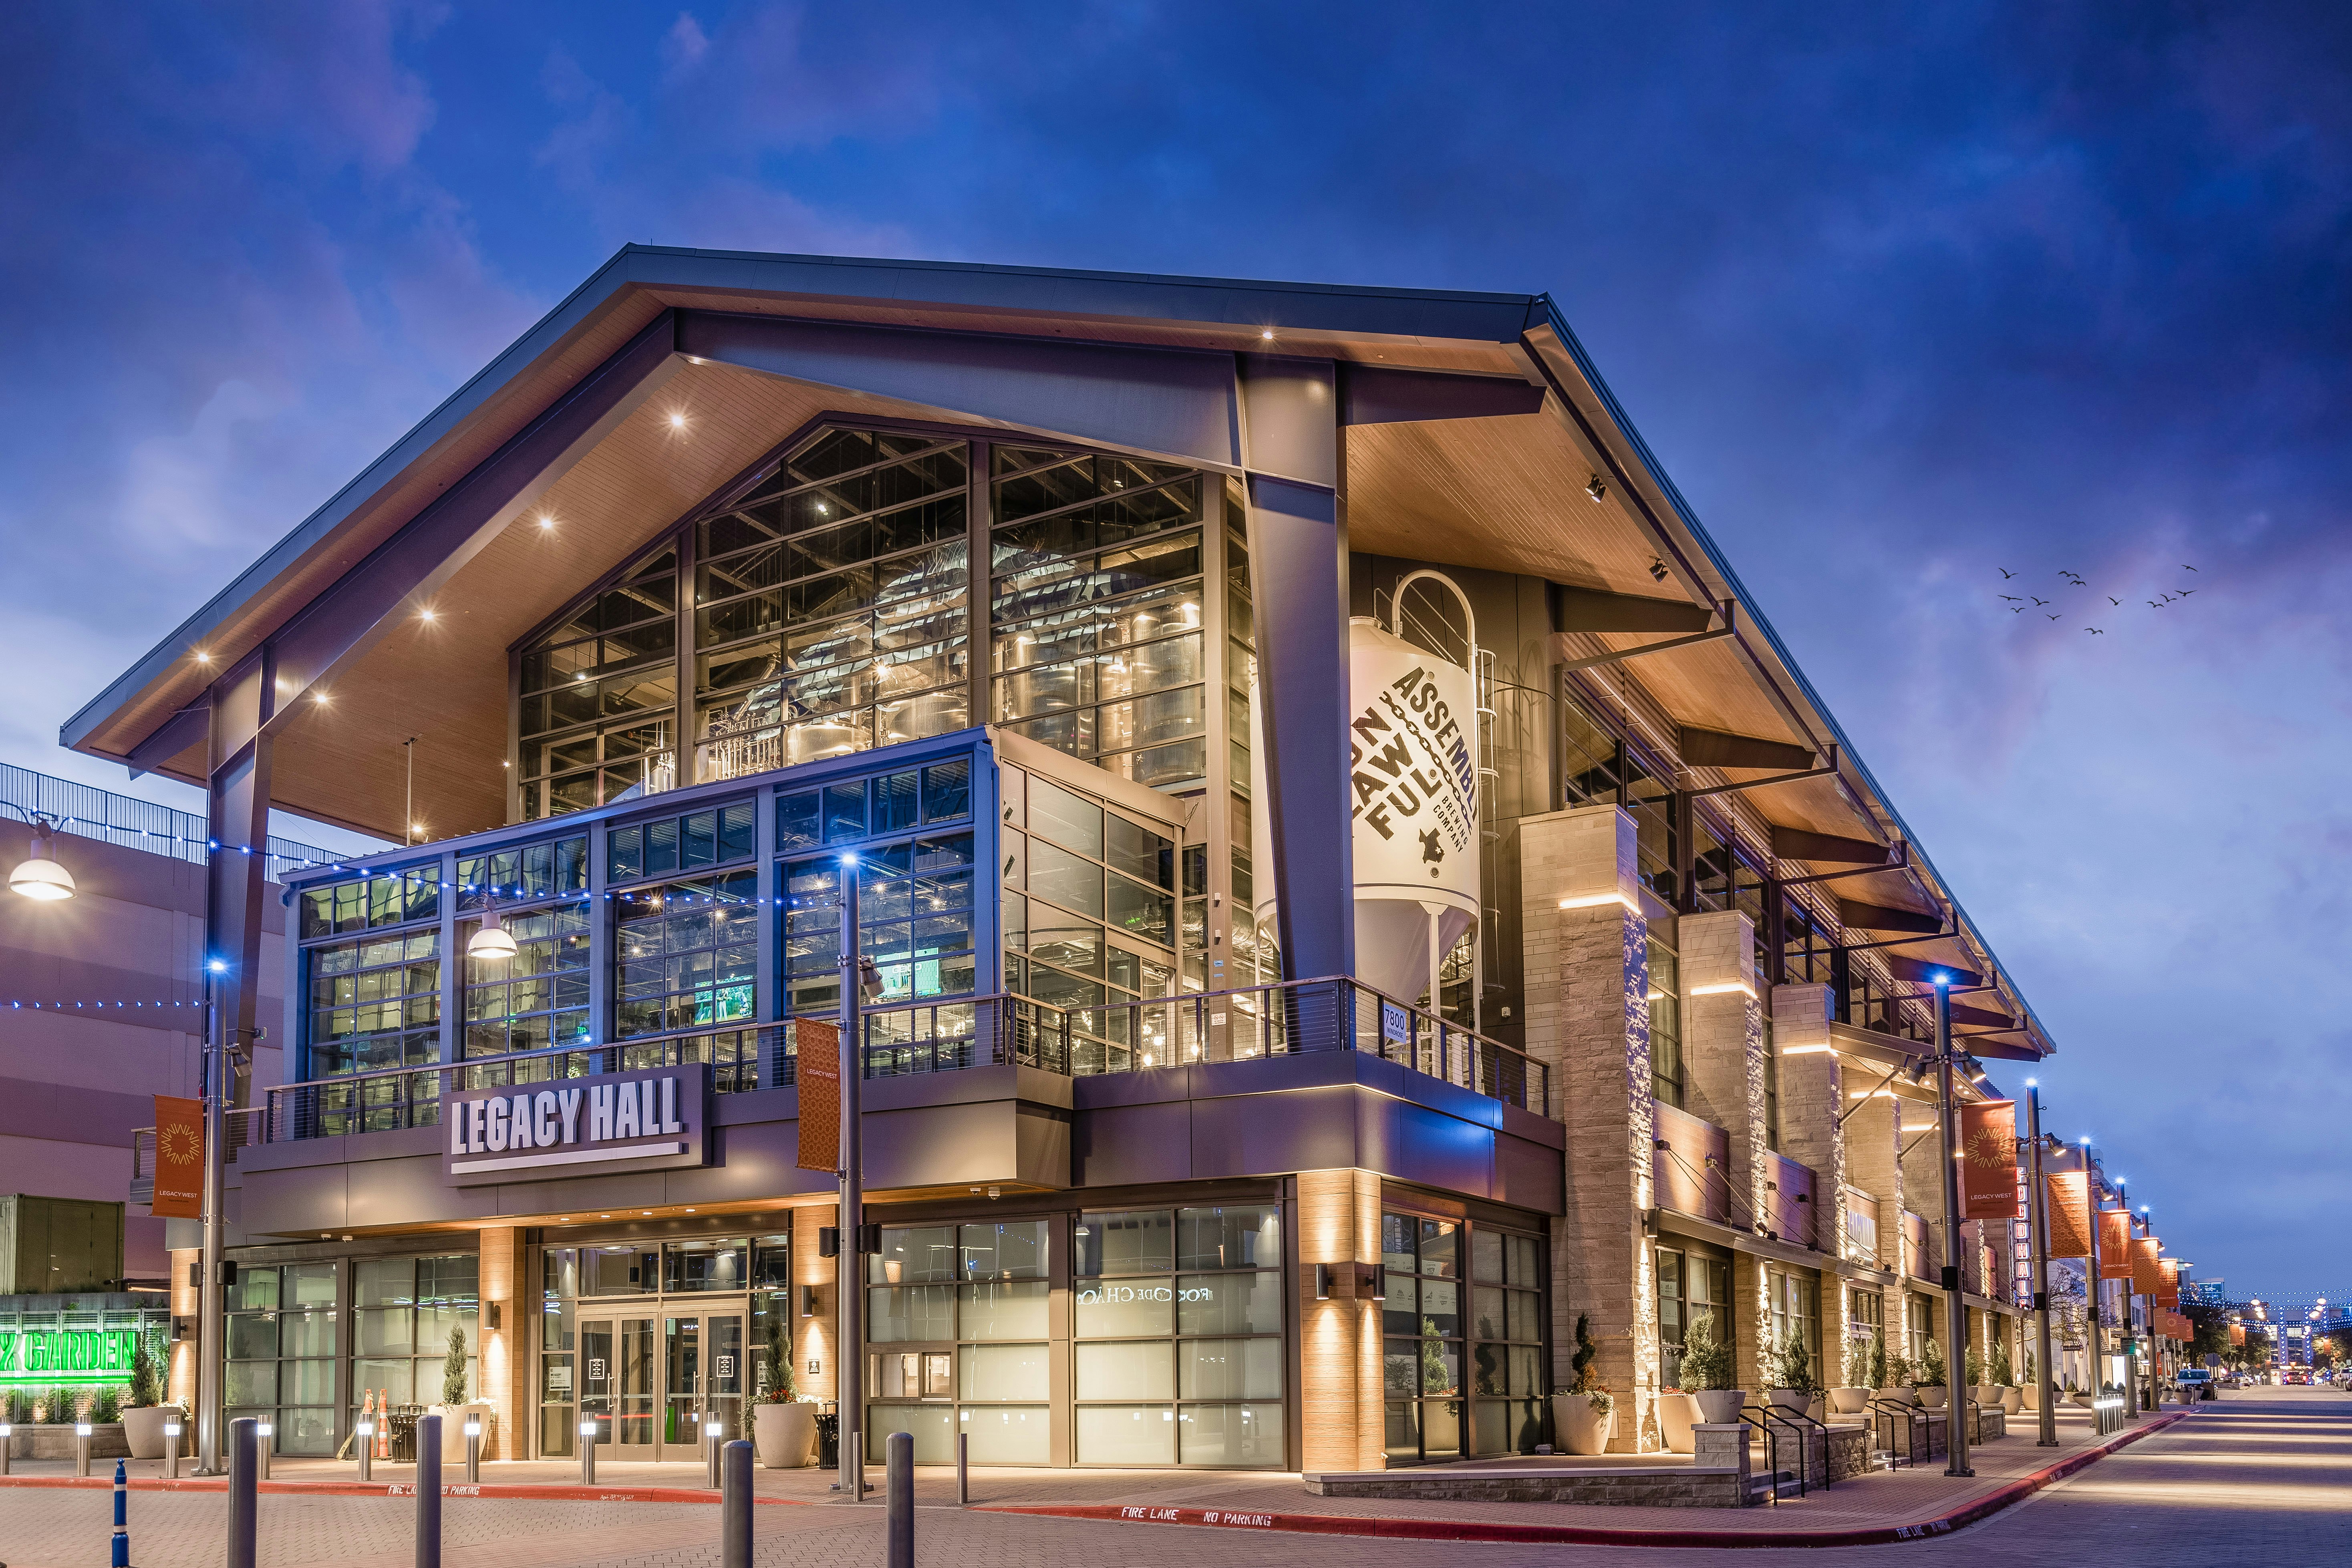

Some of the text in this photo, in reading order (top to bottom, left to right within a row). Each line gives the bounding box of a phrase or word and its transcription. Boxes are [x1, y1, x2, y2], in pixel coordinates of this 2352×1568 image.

[1392, 666, 1477, 822] ASSEMBL
[1352, 733, 1413, 819] AW
[1365, 768, 1443, 840] FUL
[1442, 795, 1468, 845] BREWING
[1433, 805, 1463, 853] COMPANY
[1385, 1008, 1404, 1030] 7800
[1387, 1027, 1404, 1039] WINDROSE
[807, 1068, 825, 1077] LEGACY
[451, 1077, 682, 1154] LEGACY HALL
[25, 1332, 136, 1371] GARDEN
[388, 1485, 405, 1495] FIRE
[406, 1485, 417, 1495] LA
[450, 1485, 480, 1496] PARKING
[1121, 1506, 1272, 1527] FIRE LANE NO PARKING
[1896, 1527, 1911, 1539] FIRE
[1909, 1525, 1925, 1536] LANE
